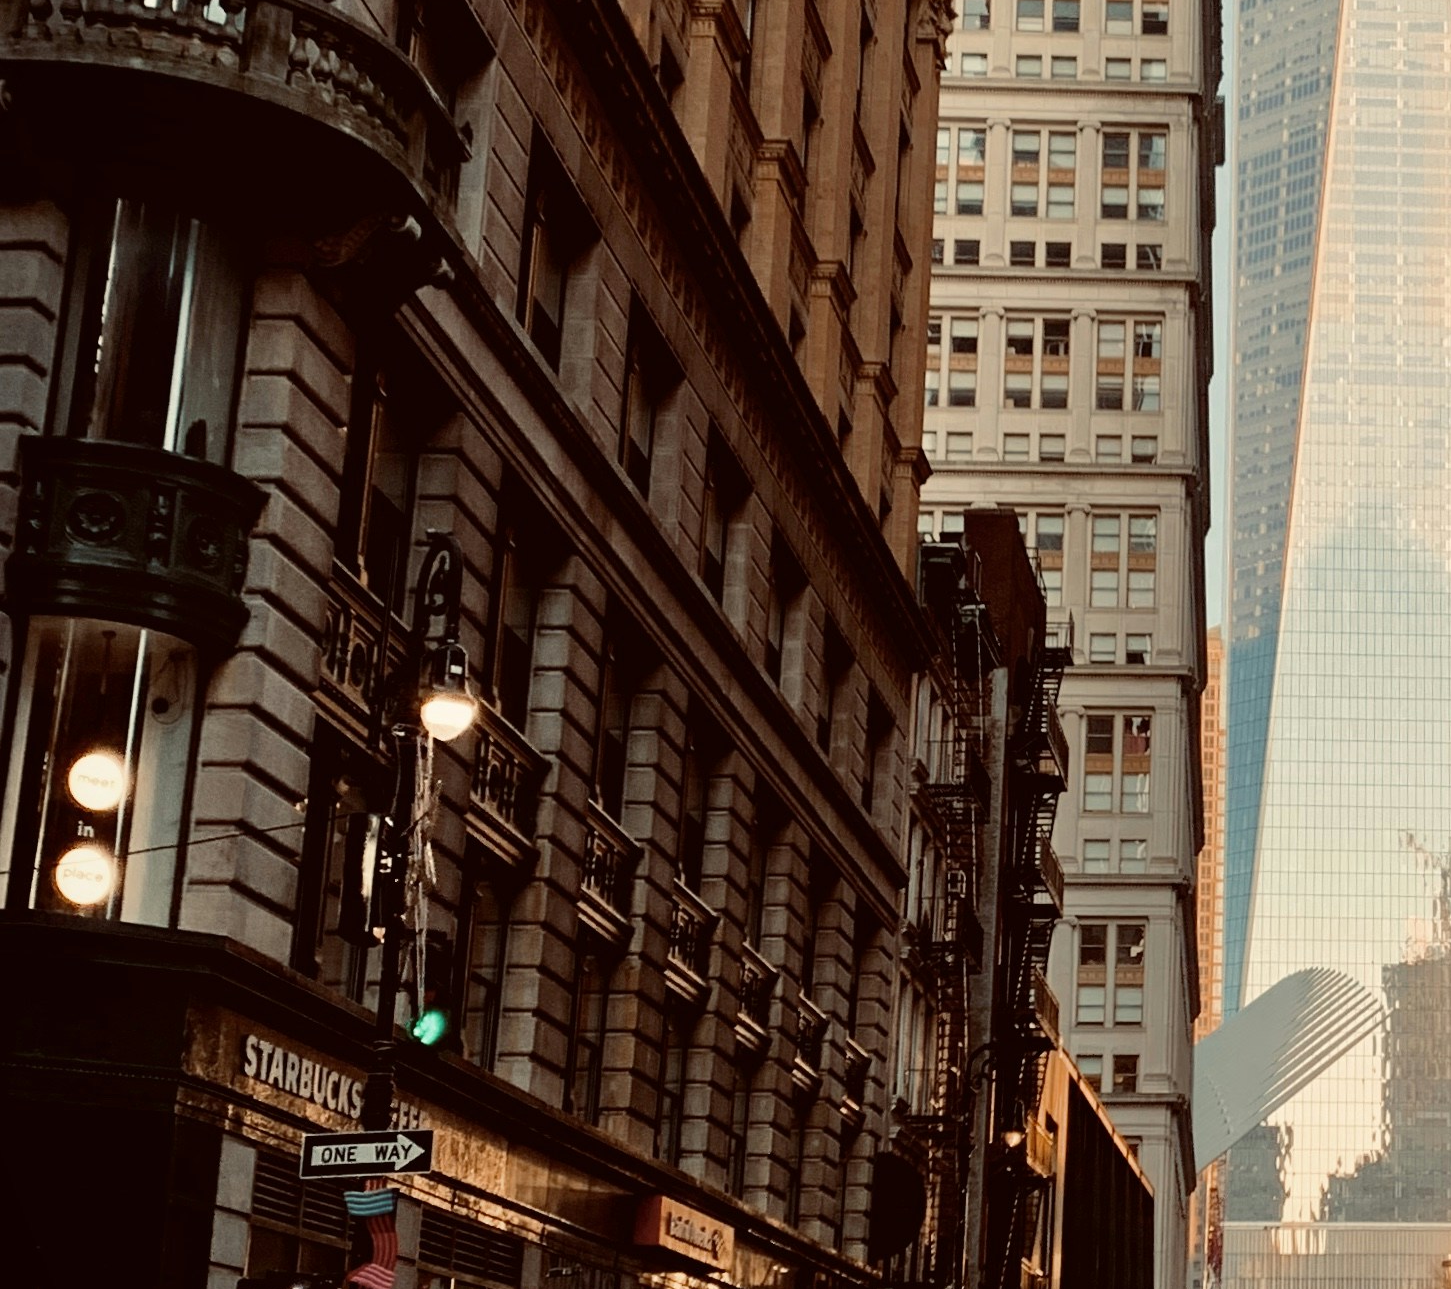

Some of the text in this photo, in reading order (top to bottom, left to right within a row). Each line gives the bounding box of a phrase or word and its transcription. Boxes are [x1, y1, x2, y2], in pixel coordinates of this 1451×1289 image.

[77, 821, 94, 838] in
[63, 867, 103, 883] place
[244, 1034, 366, 1119] STARBUCKS
[321, 1144, 413, 1163] ONE WAY
